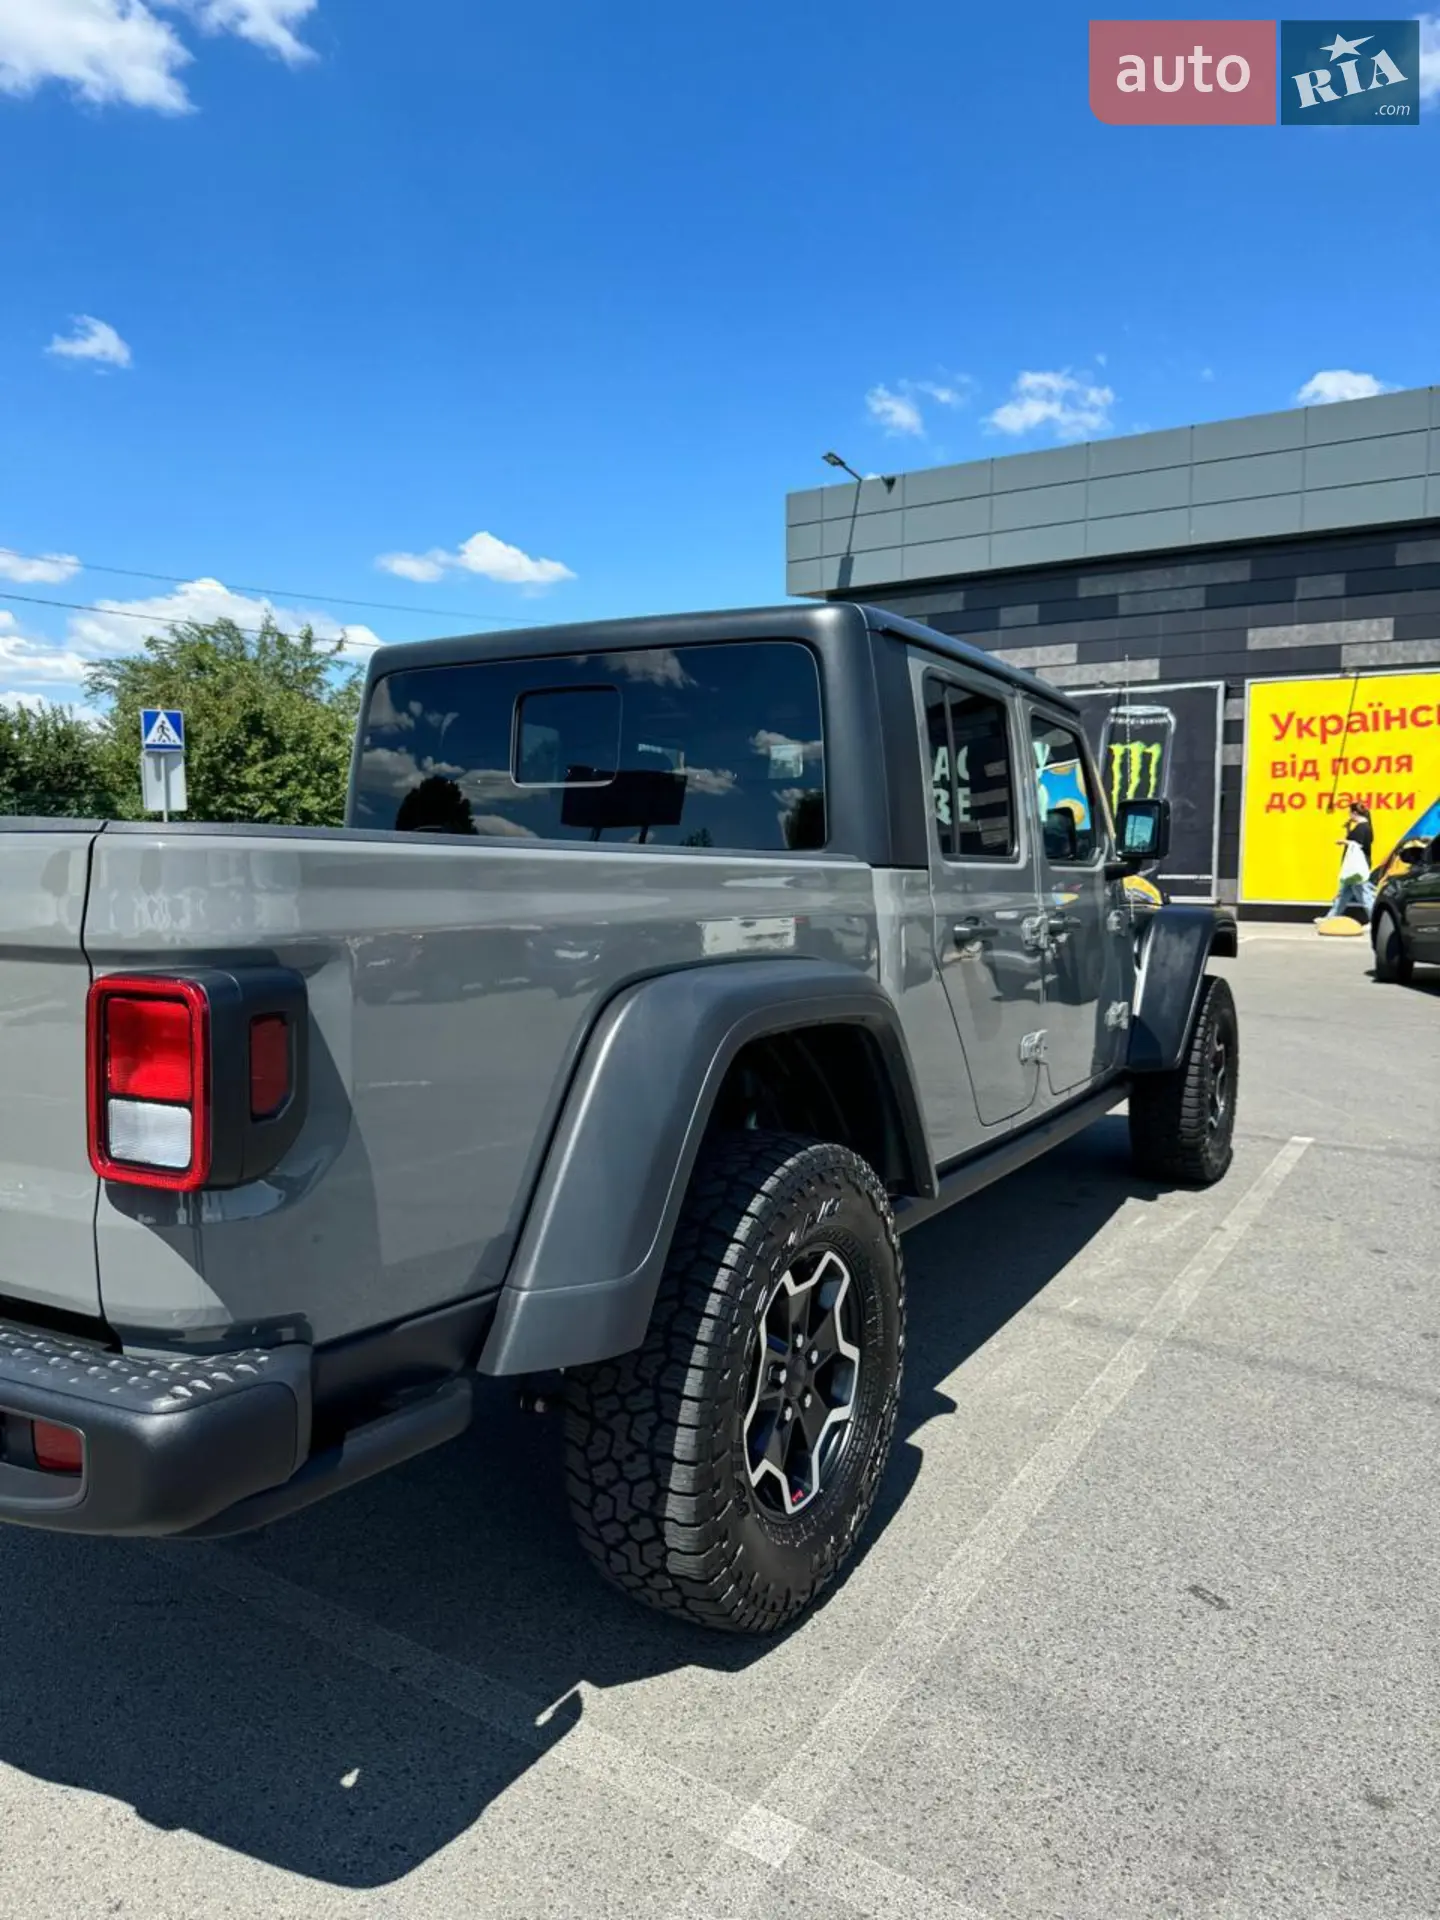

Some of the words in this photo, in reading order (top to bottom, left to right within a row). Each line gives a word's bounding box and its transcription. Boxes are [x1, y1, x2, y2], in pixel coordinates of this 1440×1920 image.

[1270, 702, 1440, 744] Українс
[1271, 753, 1320, 782] від
[1330, 754, 1414, 775] поля
[1265, 792, 1307, 813] до
[1317, 791, 1416, 811] пачки
